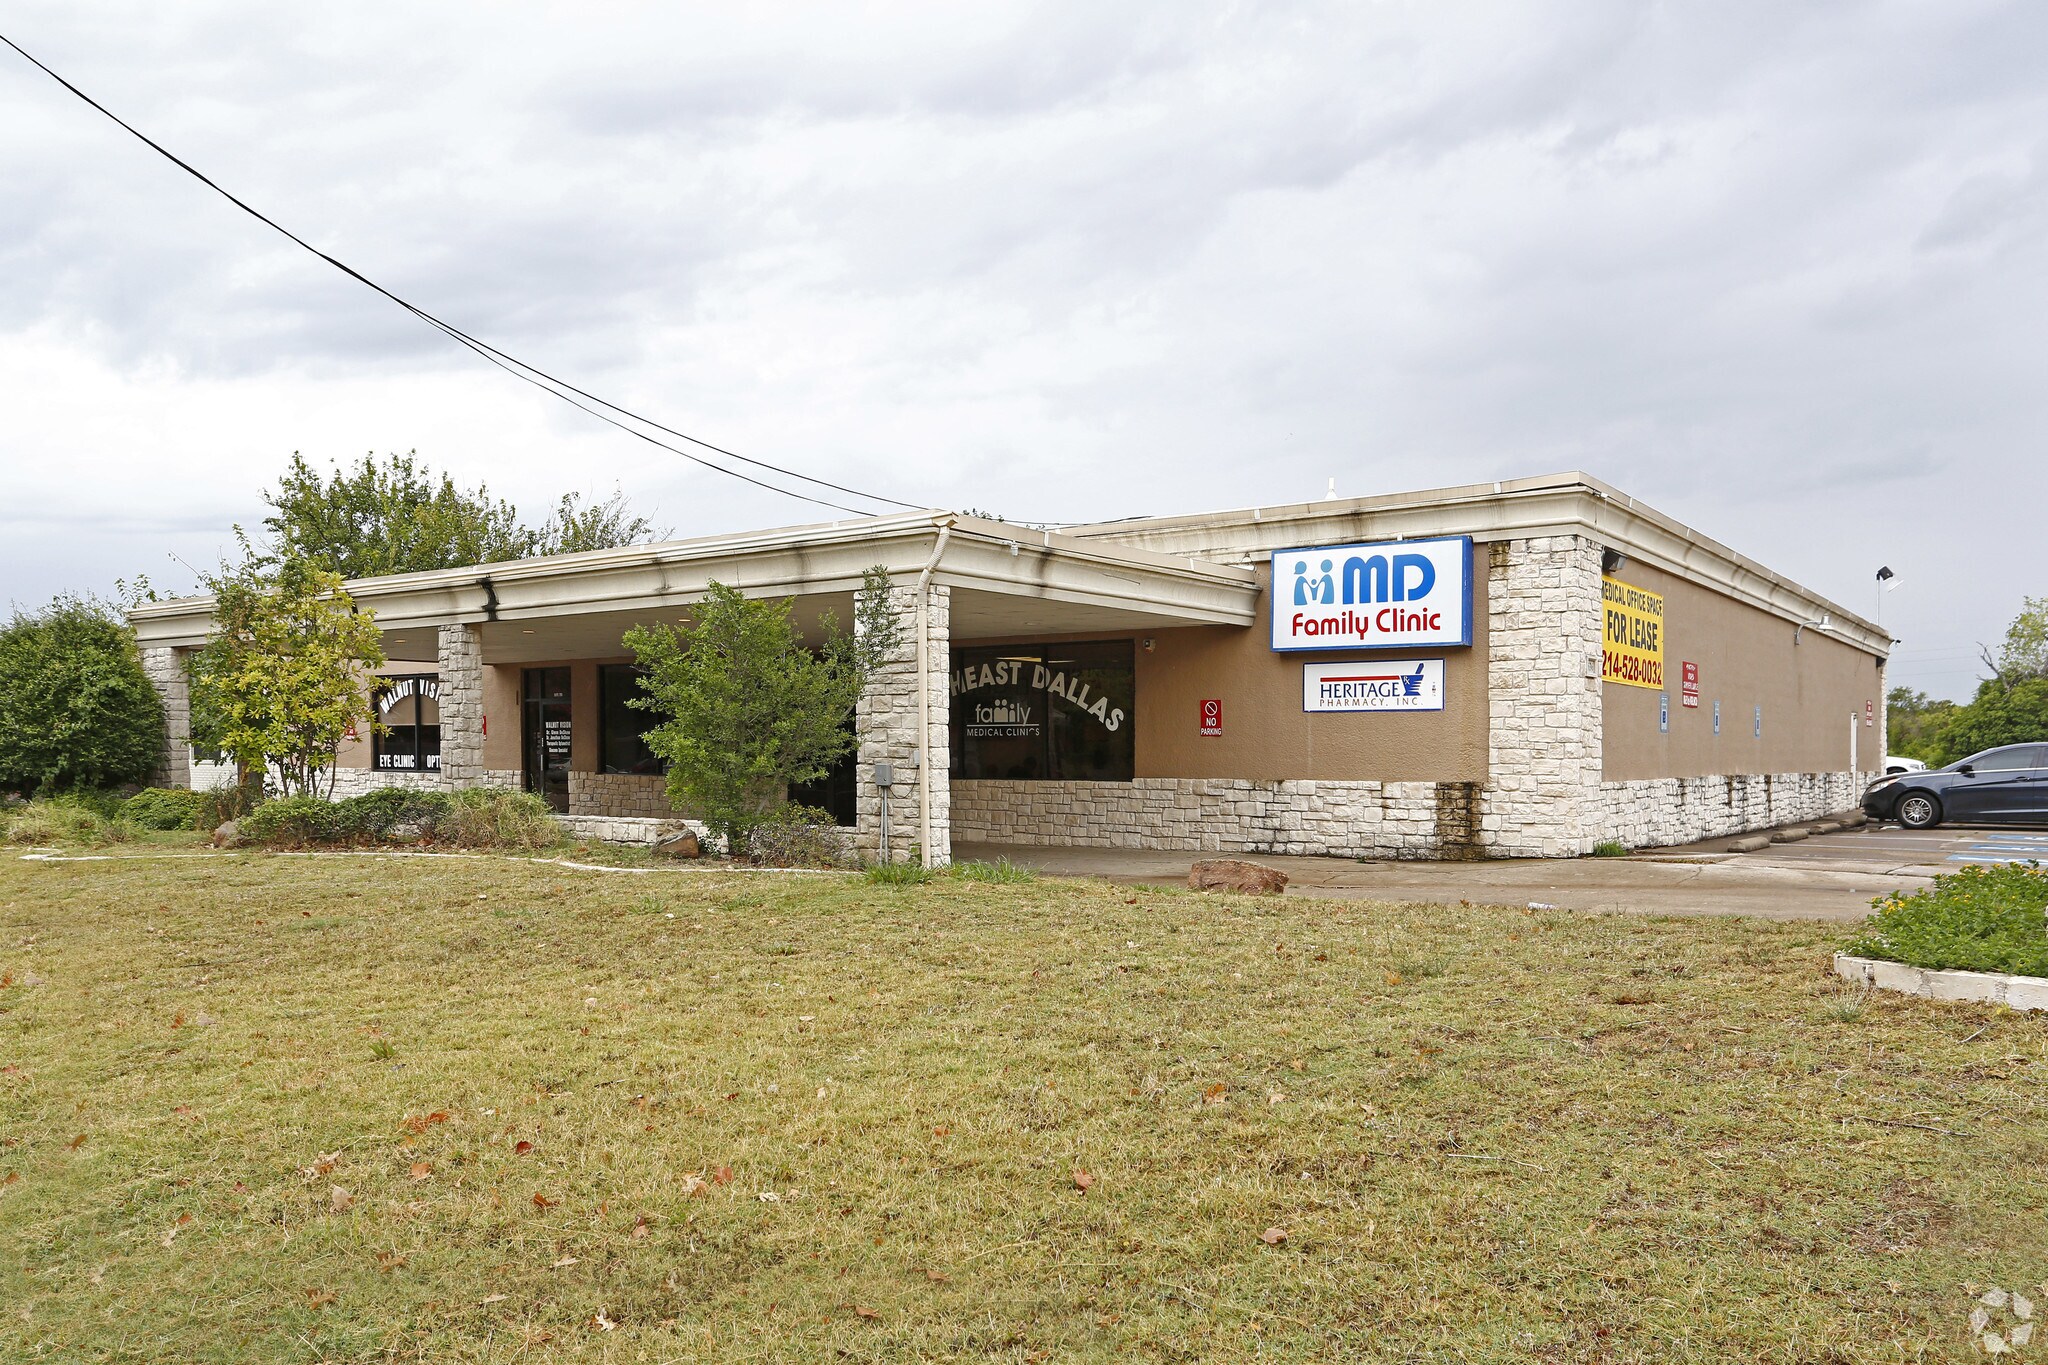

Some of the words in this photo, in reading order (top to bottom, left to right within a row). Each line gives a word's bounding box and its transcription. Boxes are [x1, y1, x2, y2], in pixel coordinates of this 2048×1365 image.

[1343, 554, 1436, 605] MD
[1626, 588, 1645, 612] OFFICE
[1292, 610, 1369, 640] Family
[1376, 607, 1441, 633] Clinic
[1607, 609, 1627, 645] FOR
[1629, 616, 1658, 652] LEASE
[1602, 649, 1662, 685] 214-528-0032
[380, 679, 414, 714] WALNUT
[1032, 664, 1125, 732] DALLAS
[1320, 682, 1400, 698] HERITAGE
[1396, 696, 1424, 706] INC.
[966, 728, 1003, 737] MEDICAL
[1200, 727, 1222, 736] PARKING
[1206, 717, 1217, 727] NO
[379, 754, 392, 768] EYE
[393, 754, 415, 768] CLINIC
